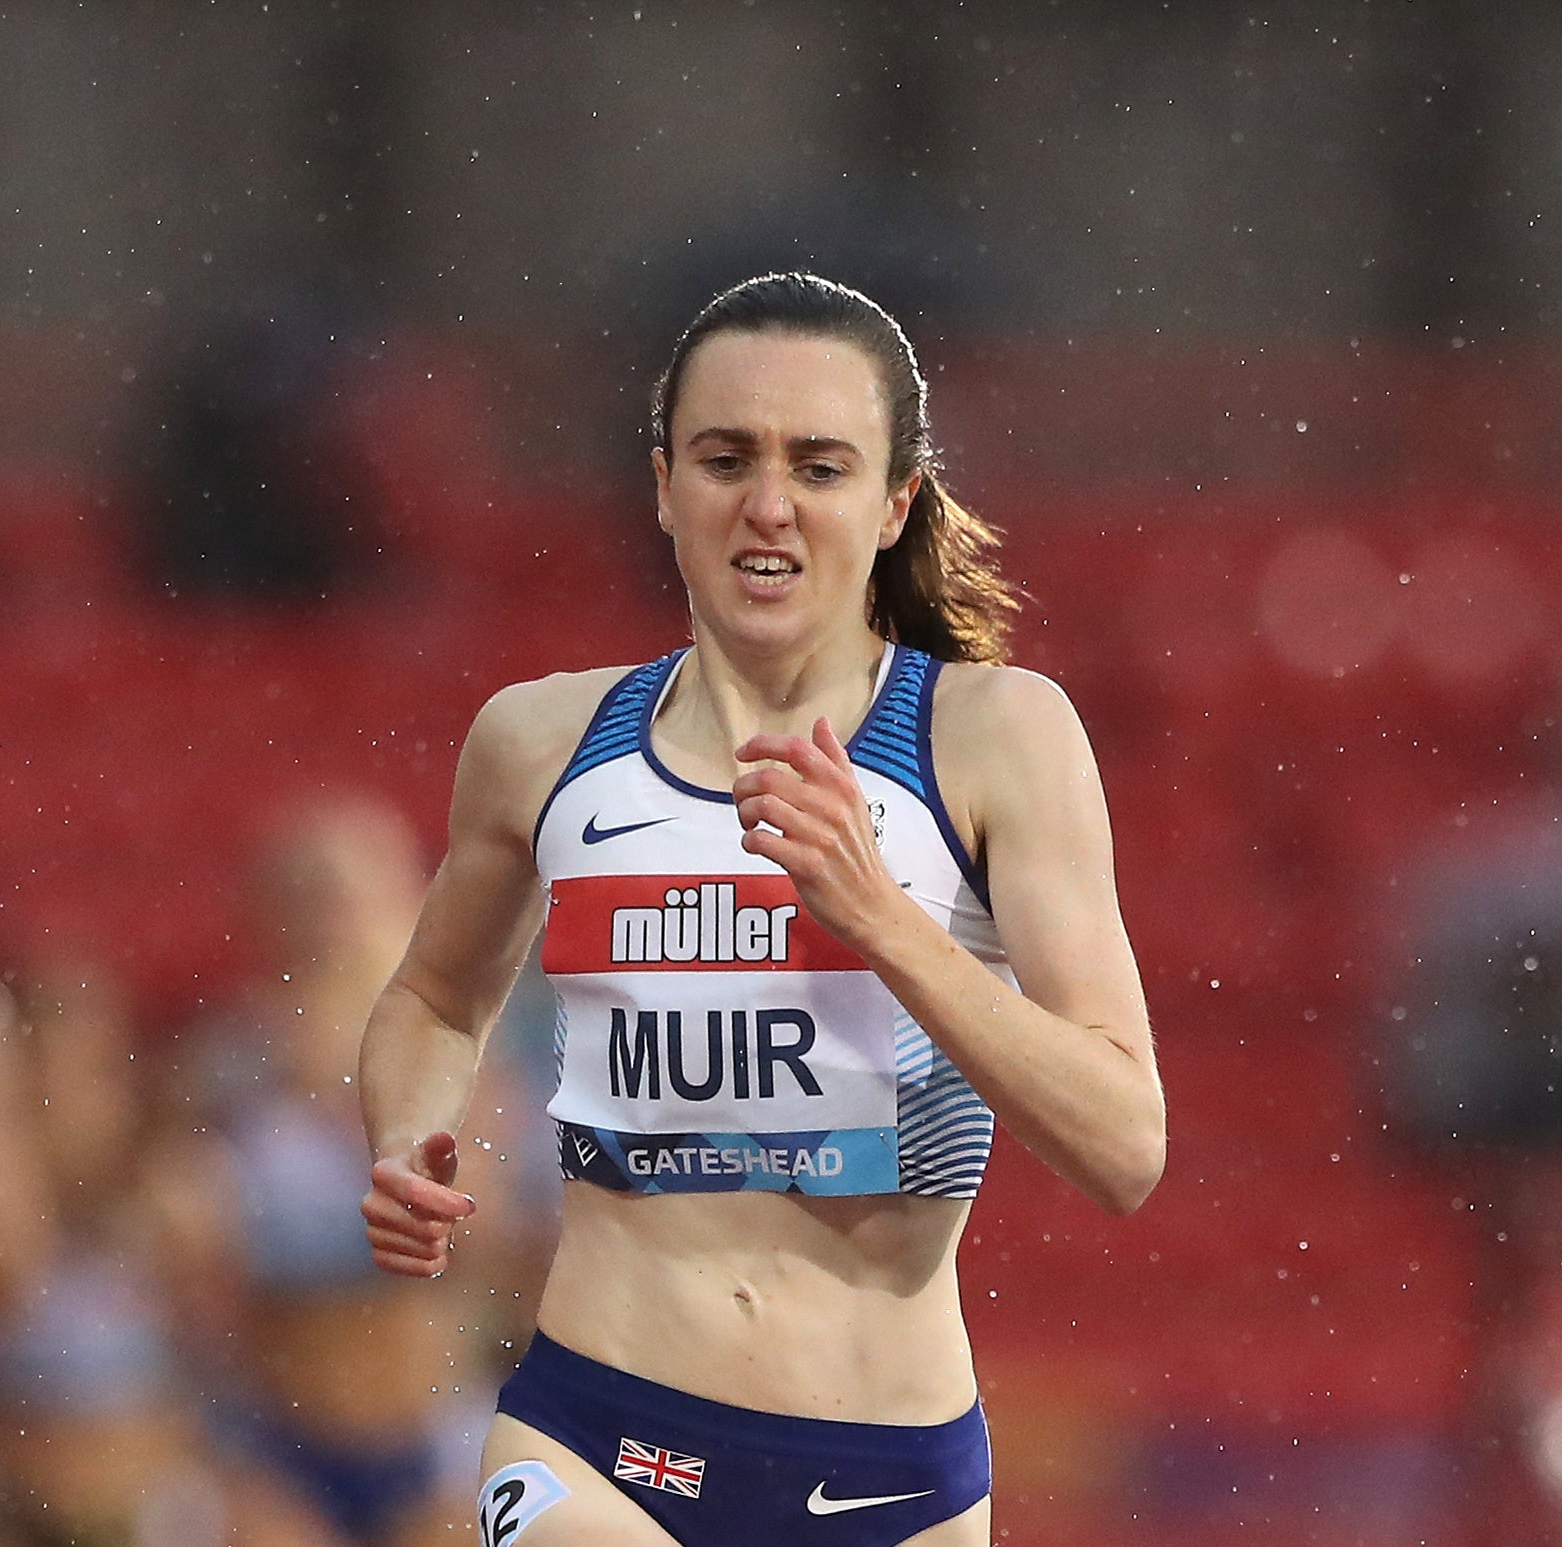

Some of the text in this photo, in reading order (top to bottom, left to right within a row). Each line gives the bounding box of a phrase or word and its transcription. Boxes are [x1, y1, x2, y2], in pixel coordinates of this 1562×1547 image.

[611, 883, 797, 963] müller
[609, 1007, 824, 1101] MUIR
[627, 1147, 843, 1177] GATESHEAD
